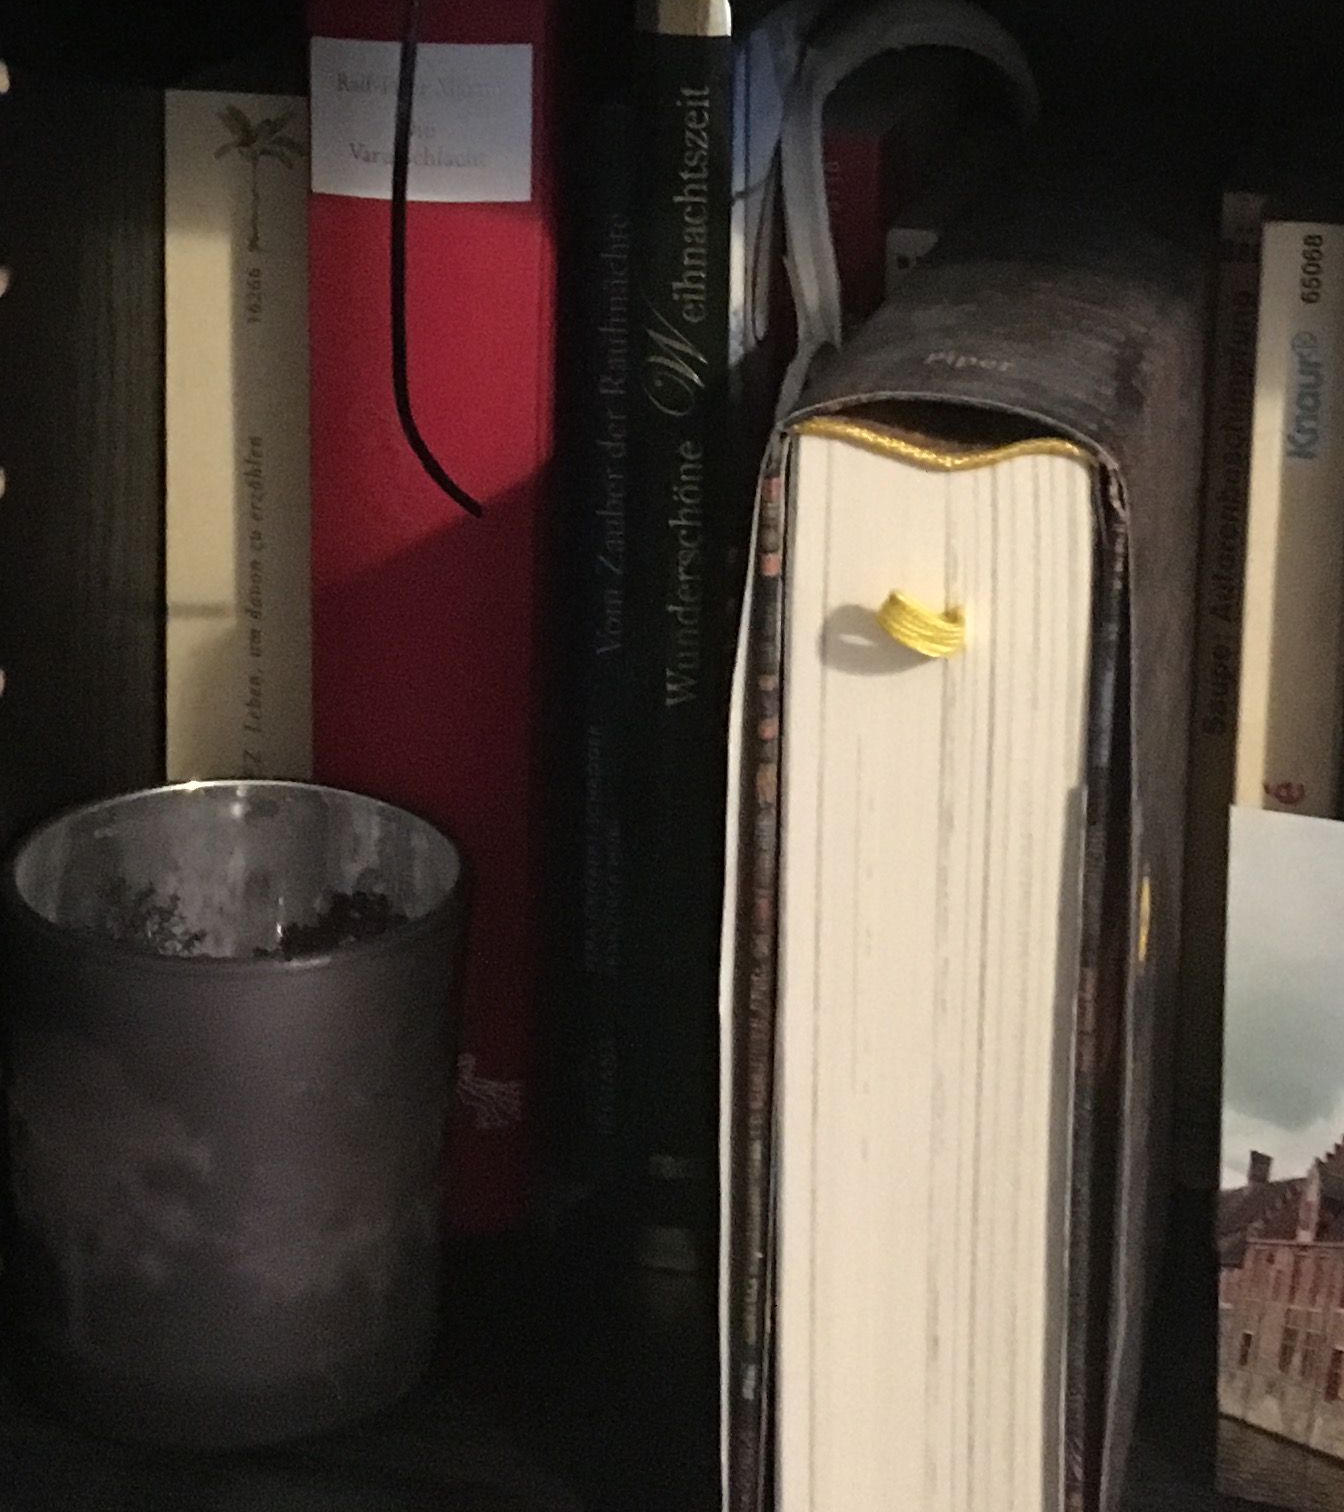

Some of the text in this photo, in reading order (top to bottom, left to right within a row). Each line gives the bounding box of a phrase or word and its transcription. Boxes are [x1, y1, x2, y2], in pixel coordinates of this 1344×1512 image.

[1299, 233, 1323, 304] 65068
[642, 85, 710, 708] Wunderschöne Weihnachtszeit
[244, 560, 262, 620] davon
